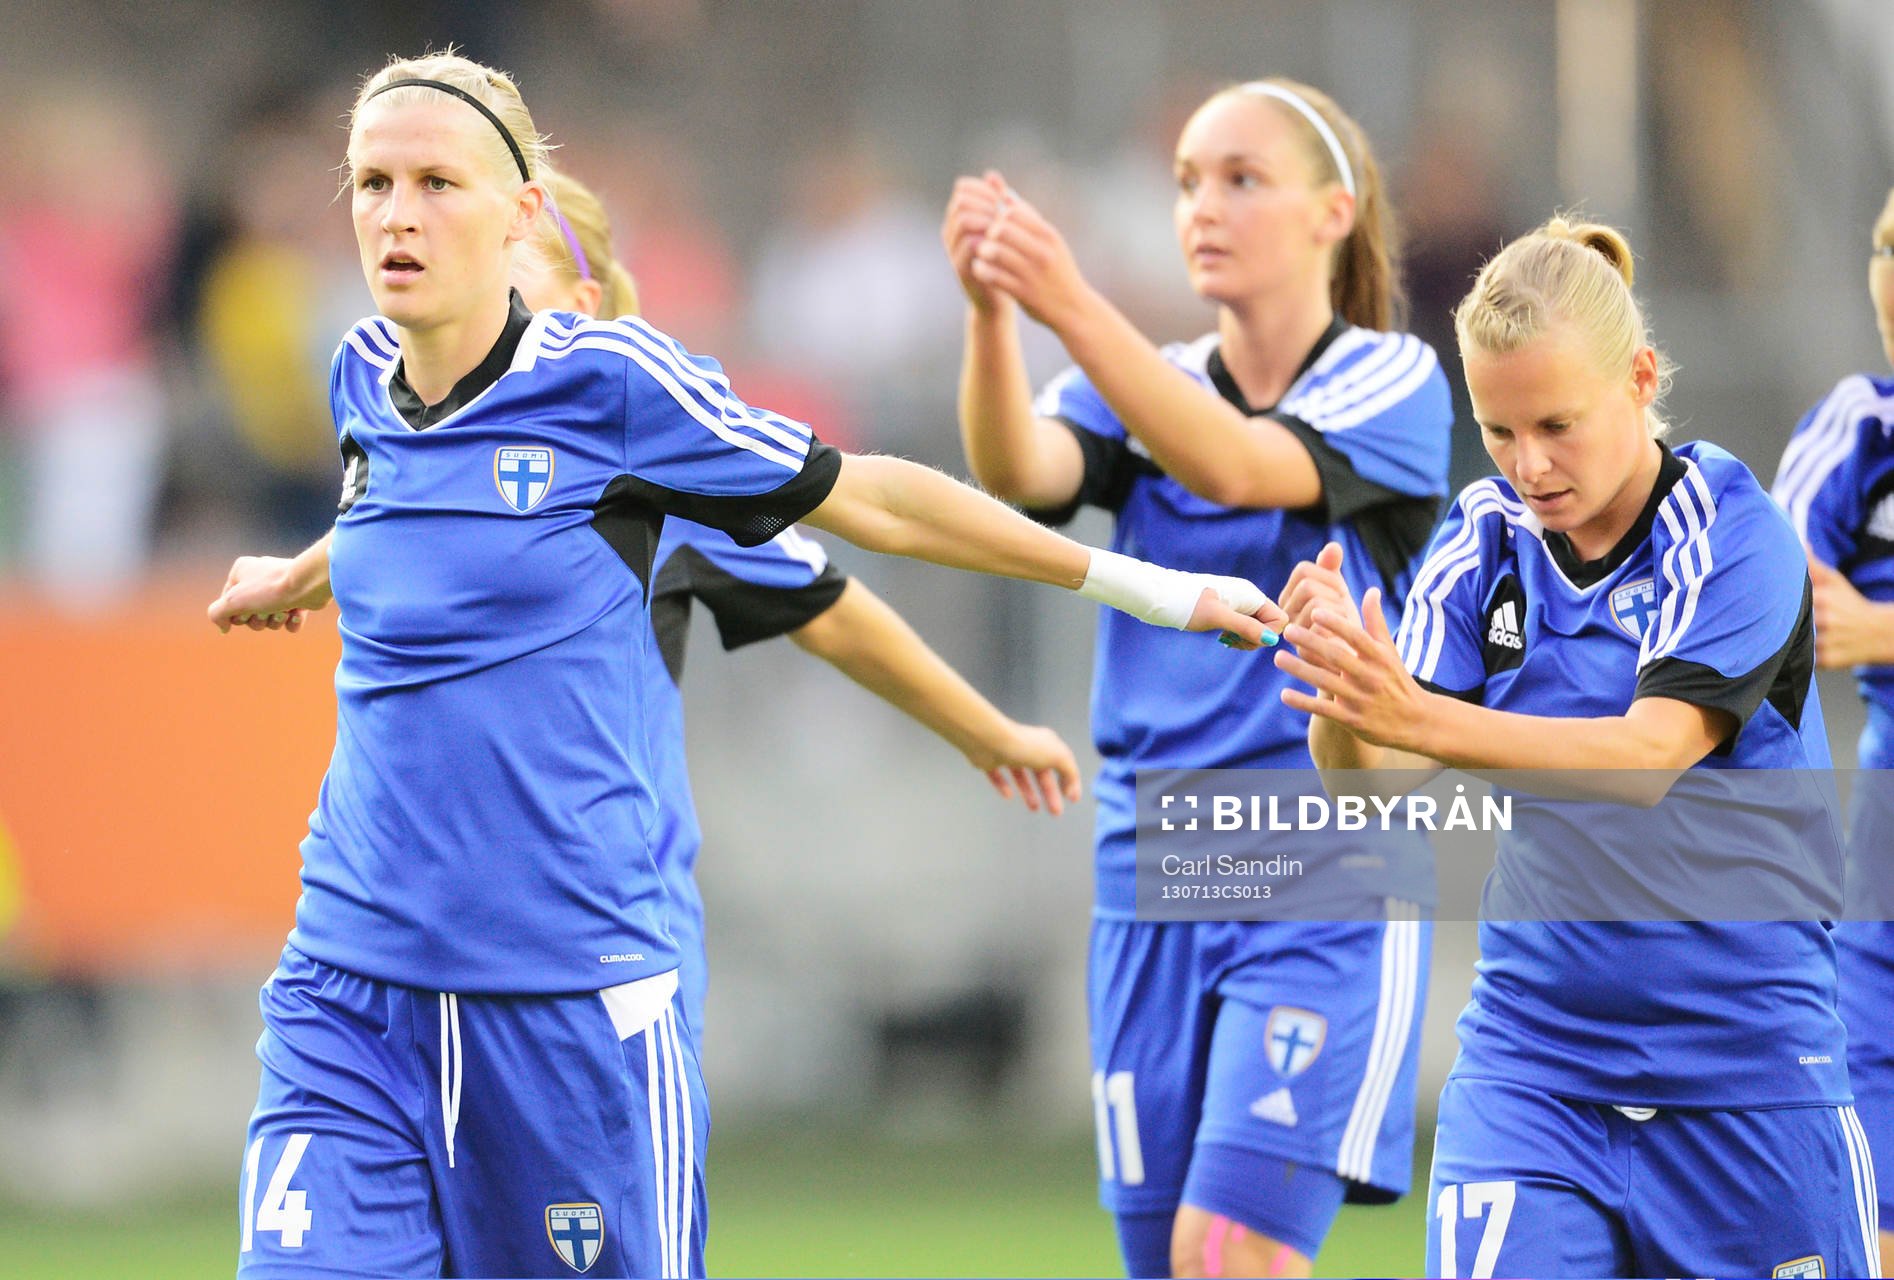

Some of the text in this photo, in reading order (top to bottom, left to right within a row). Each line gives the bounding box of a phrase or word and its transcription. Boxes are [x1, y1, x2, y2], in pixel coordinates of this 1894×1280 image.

[1618, 583, 1653, 598] SUOMI
[600, 953, 645, 963] CLIMACOOL
[1092, 1069, 1145, 1185] 11
[241, 1133, 313, 1252] 14
[1436, 1181, 1516, 1279] 17
